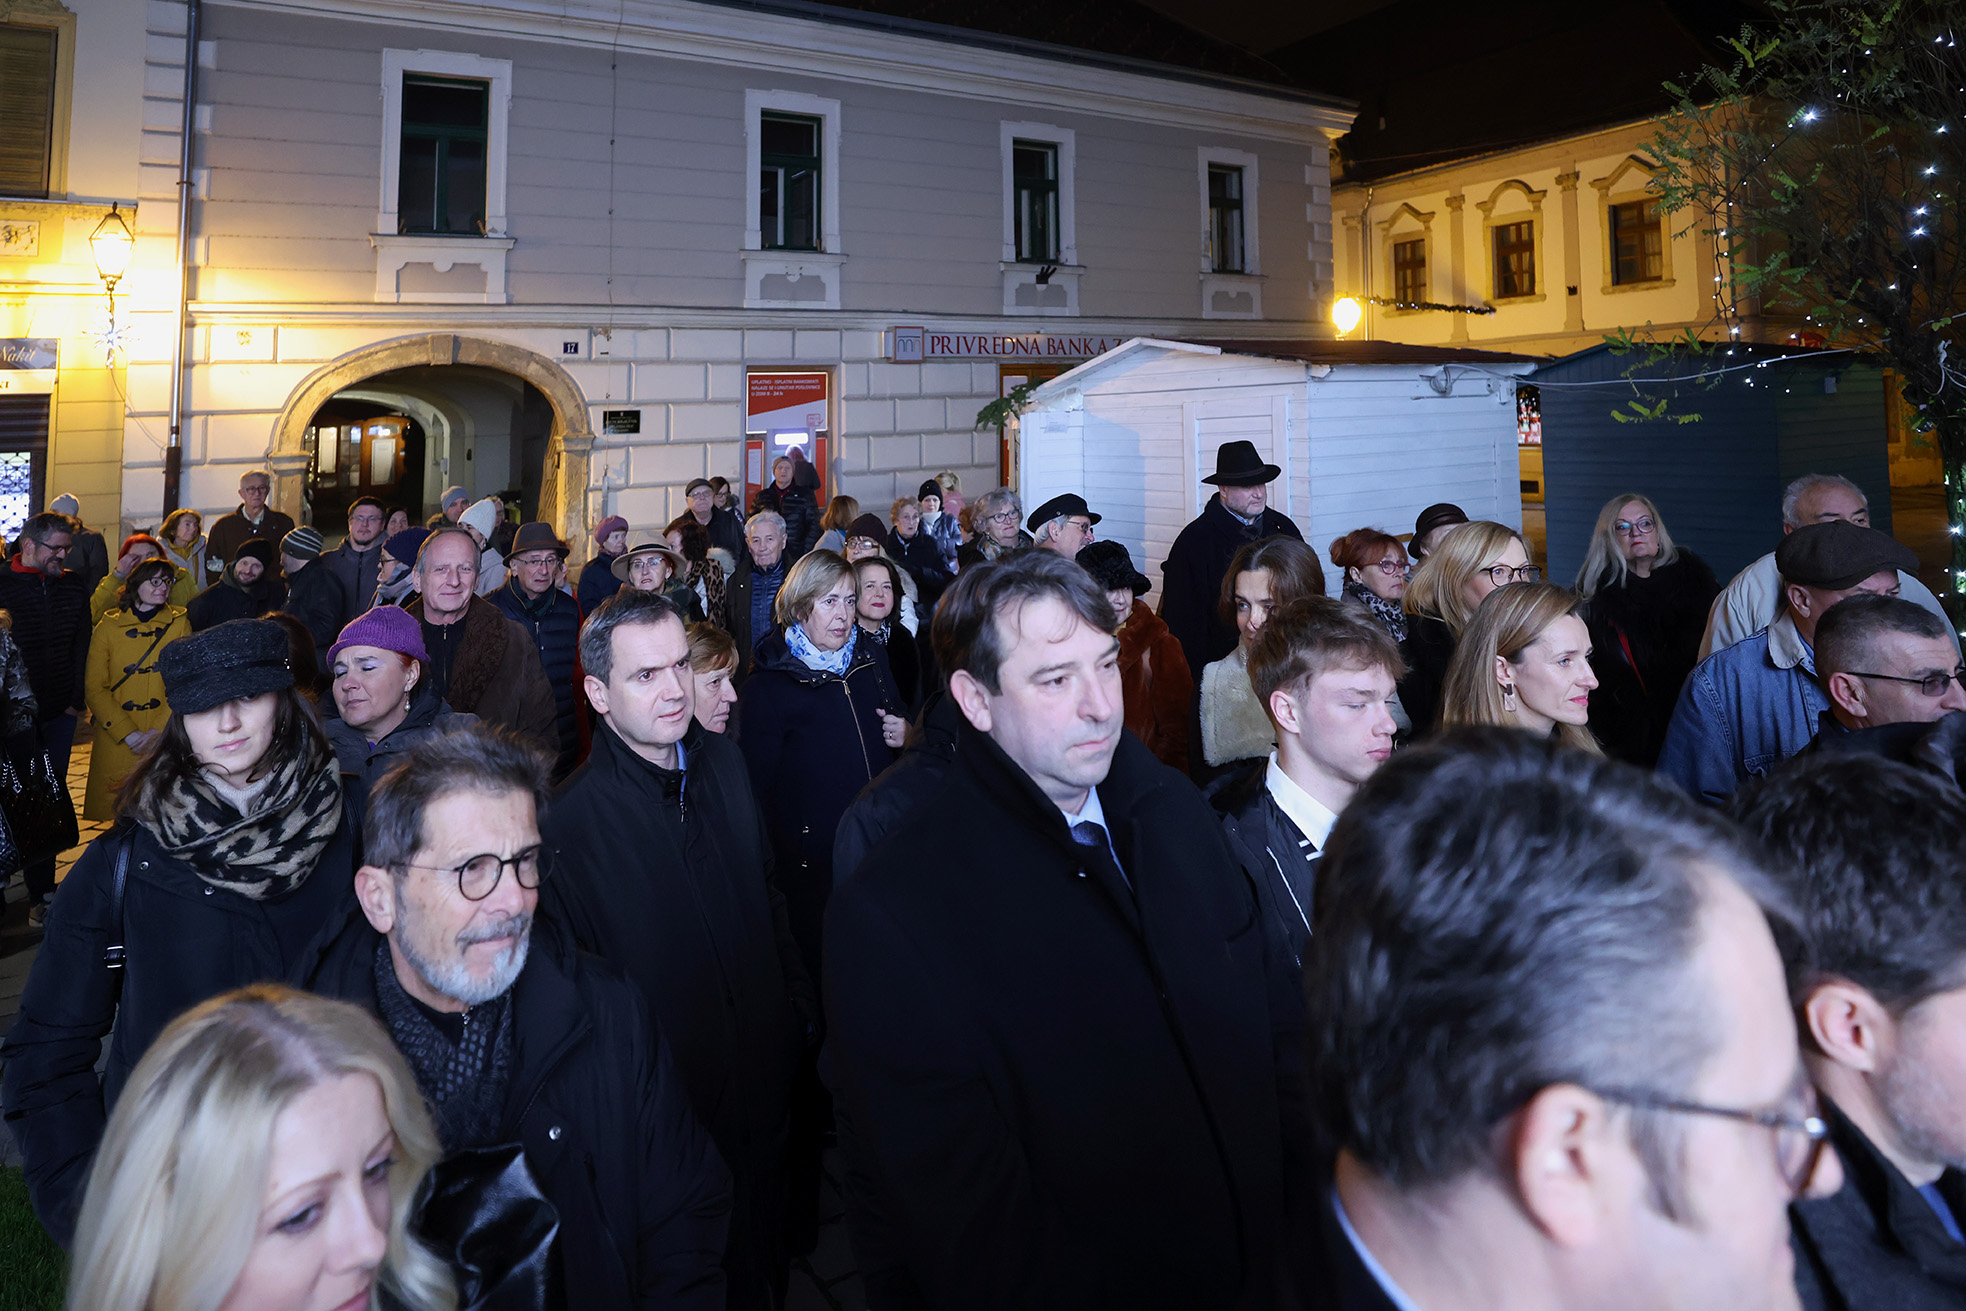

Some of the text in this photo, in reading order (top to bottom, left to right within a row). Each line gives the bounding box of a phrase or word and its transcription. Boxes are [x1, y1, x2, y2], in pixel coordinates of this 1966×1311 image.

[567, 343, 576, 353] 17
[930, 335, 1042, 355] PRIVREDNA
[1047, 337, 1107, 355] BANKA
[1, 346, 36, 362] Nakit
